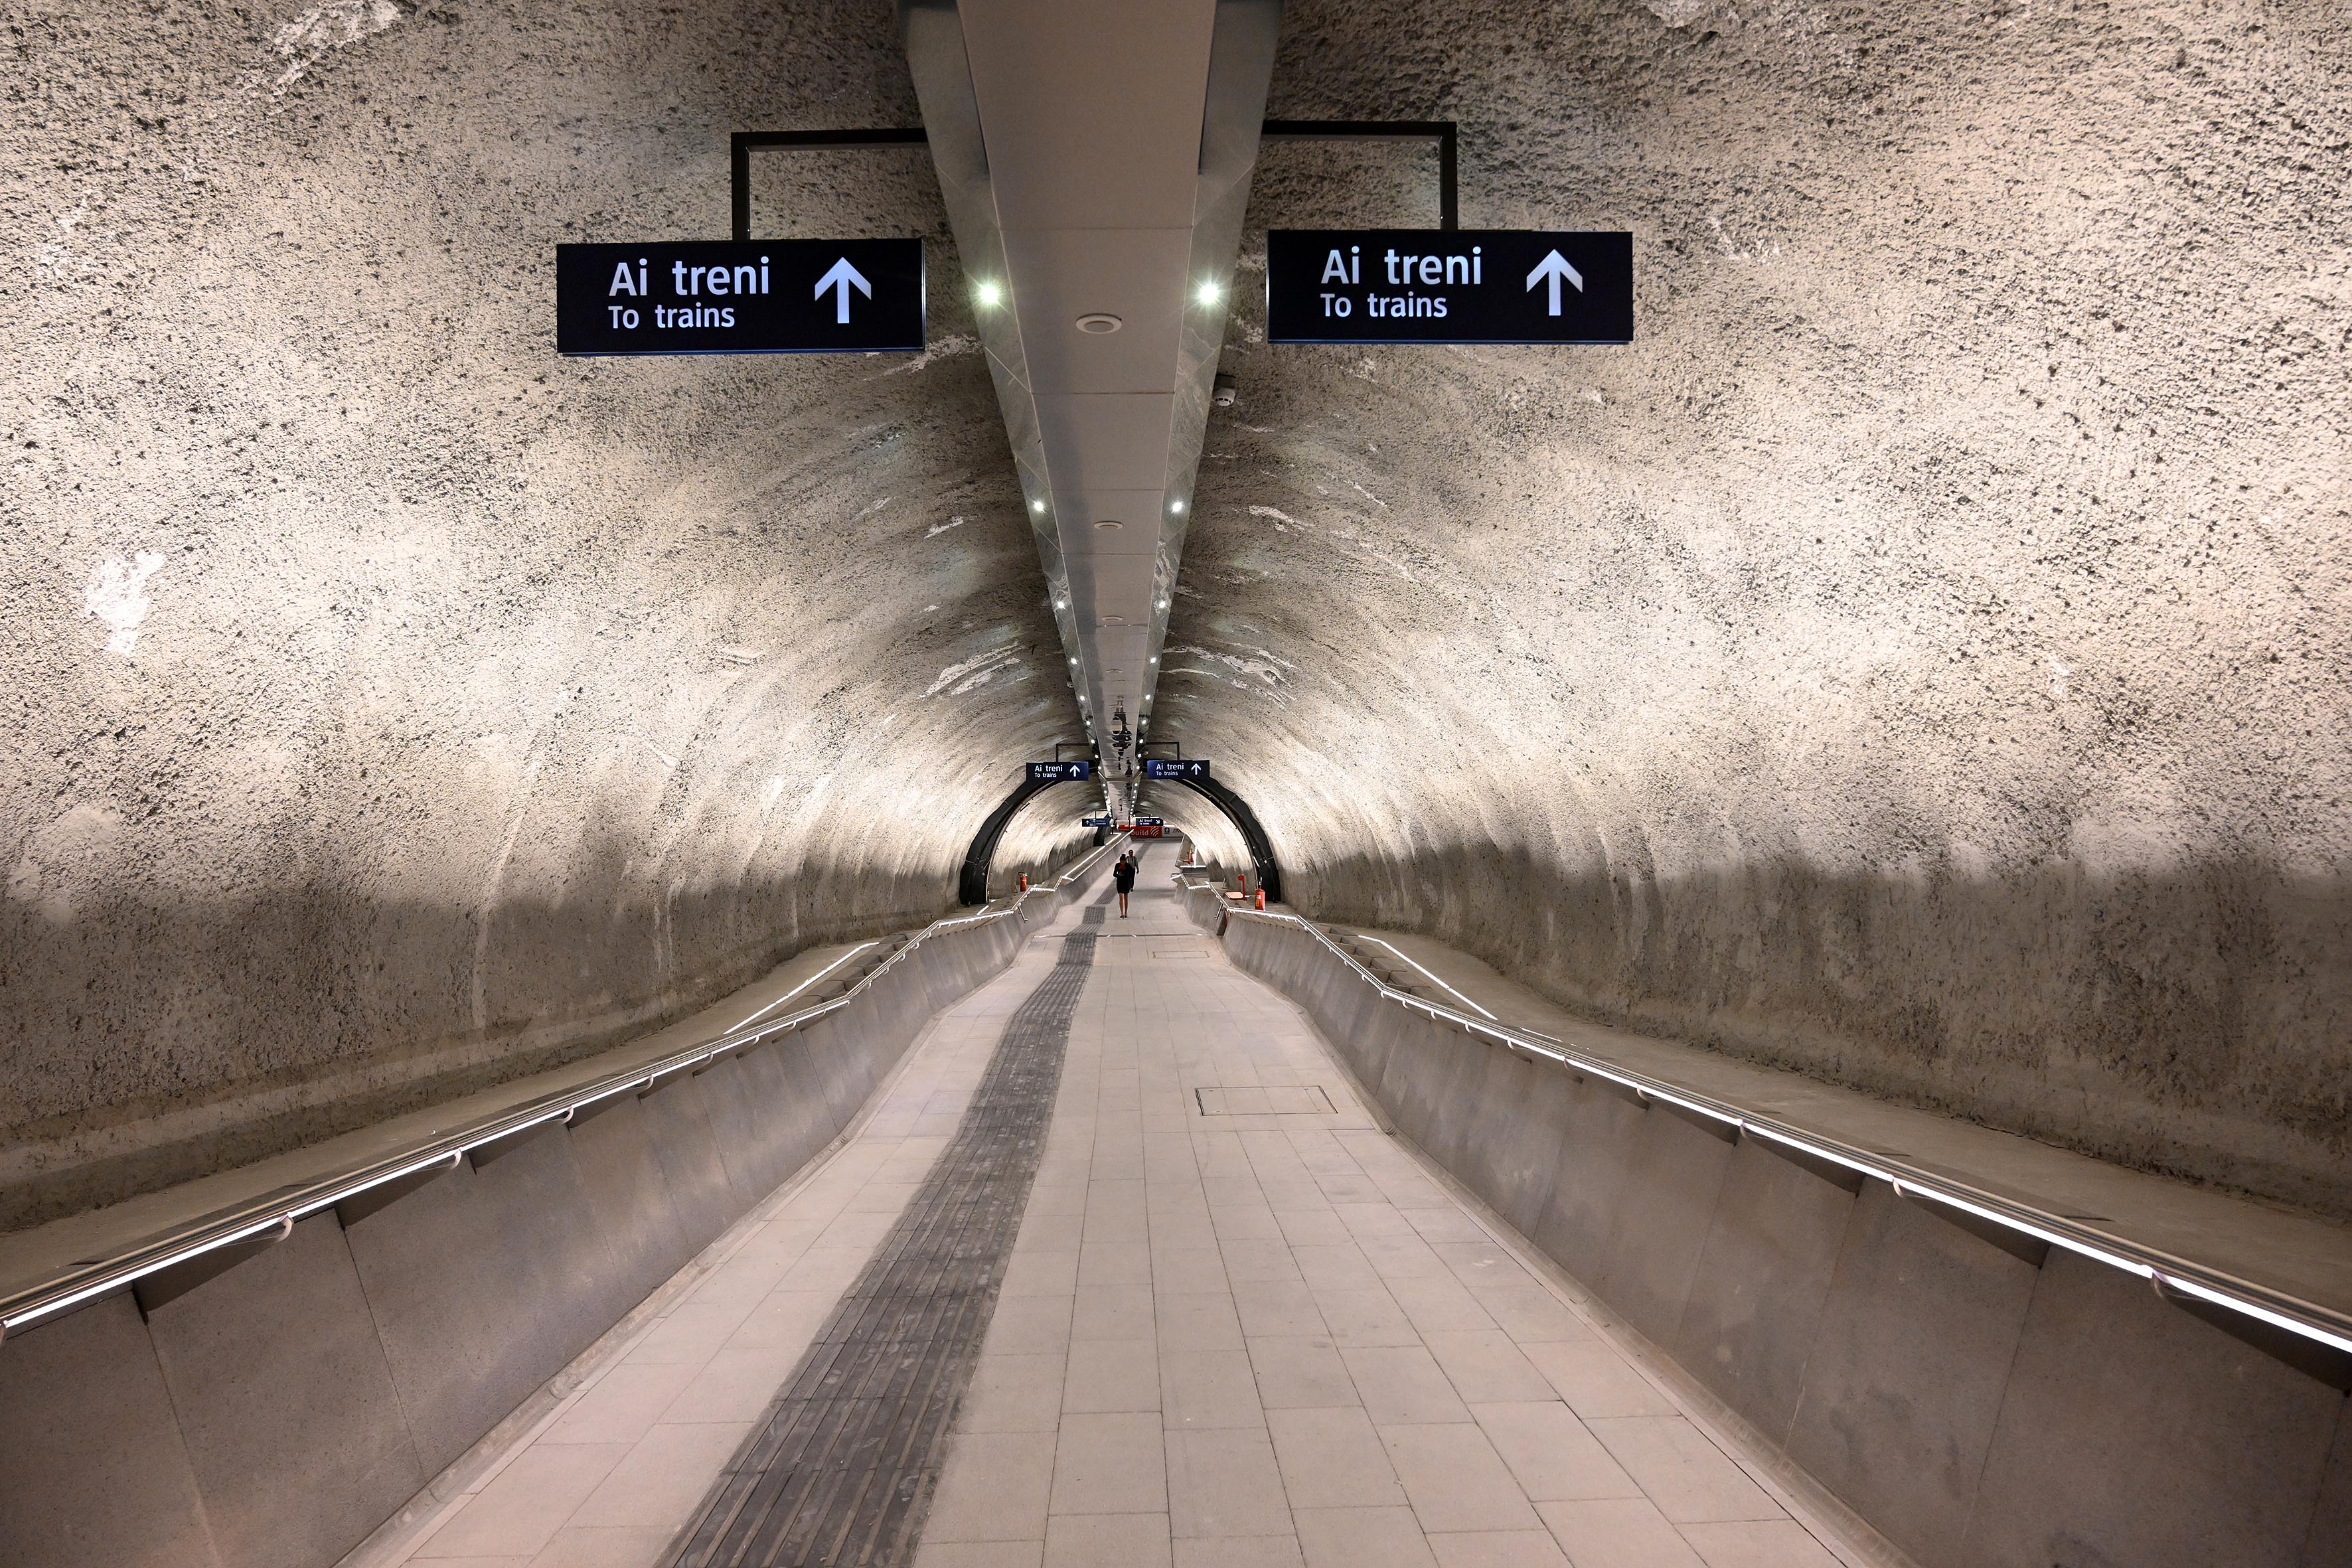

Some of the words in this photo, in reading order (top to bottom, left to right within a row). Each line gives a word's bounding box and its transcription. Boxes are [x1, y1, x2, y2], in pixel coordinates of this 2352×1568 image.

[609, 258, 647, 296] Ai
[672, 256, 769, 295] treni
[1322, 246, 1359, 283] Ai
[1385, 246, 1481, 284] treni
[608, 306, 639, 329] To
[655, 302, 734, 328] trains
[1320, 294, 1351, 317] To
[1368, 291, 1447, 317] trains
